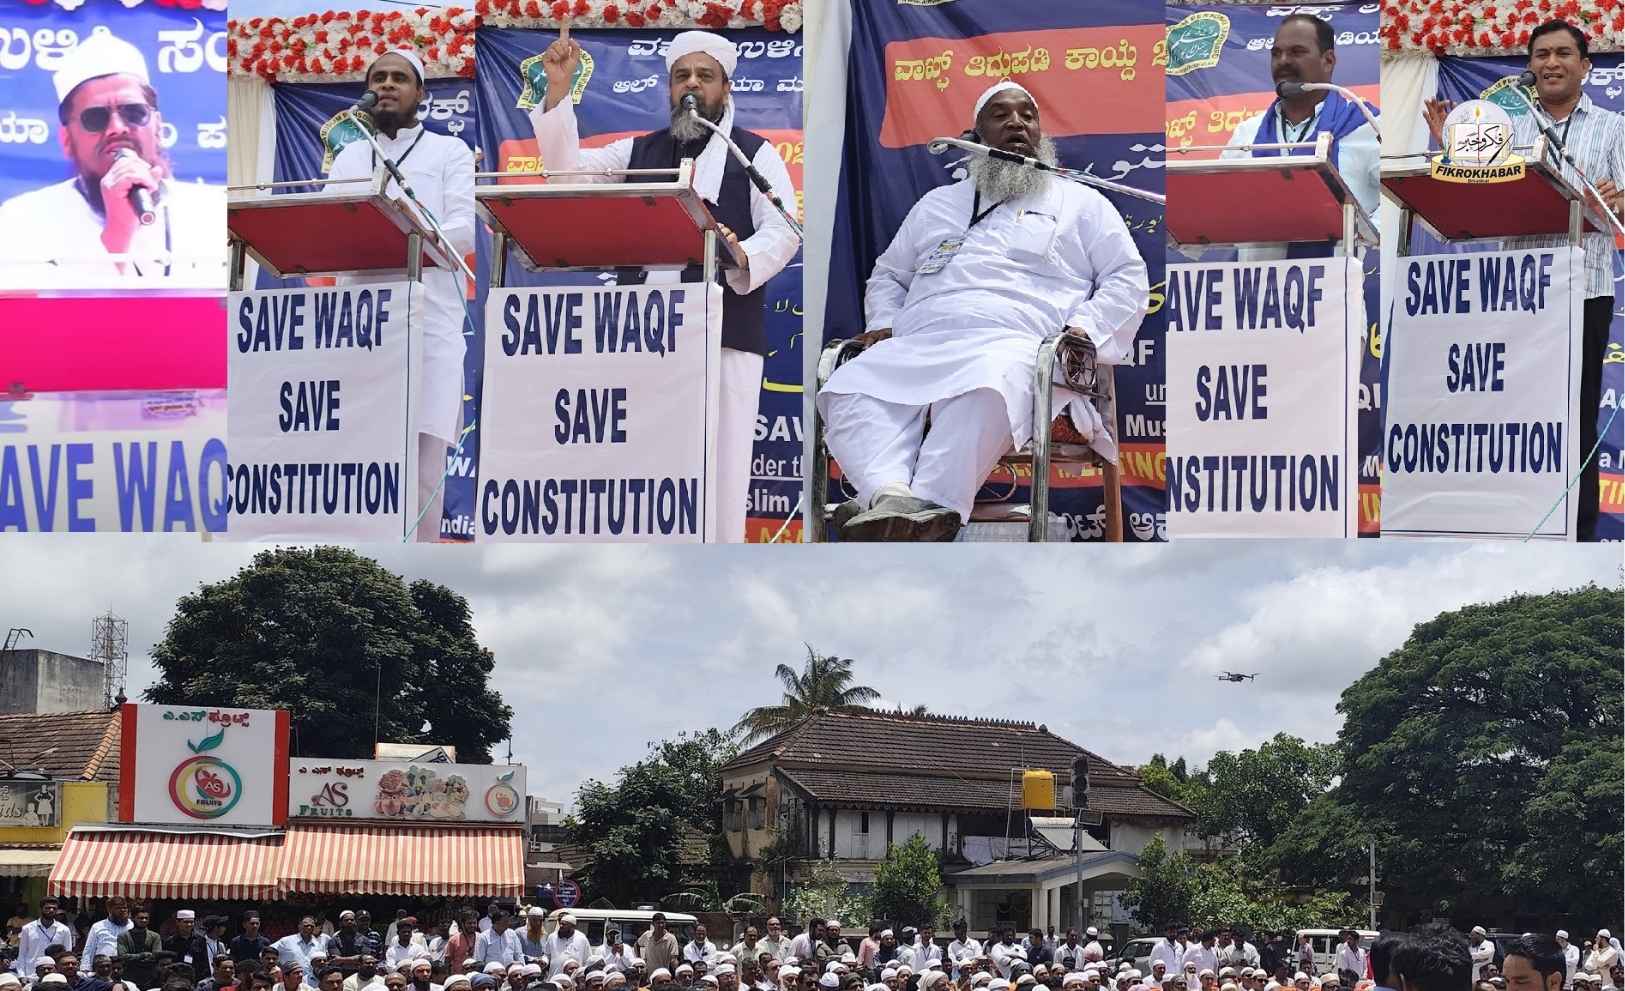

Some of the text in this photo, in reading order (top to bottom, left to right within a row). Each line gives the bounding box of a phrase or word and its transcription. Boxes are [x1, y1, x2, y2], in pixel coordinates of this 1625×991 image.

[1233, 265, 1325, 333] WAQF
[1405, 254, 1554, 317] SAVE WAQF
[237, 289, 392, 353] SAVE WAQF
[502, 290, 685, 358] SAVE WAQF
[1195, 364, 1267, 421] SAVE
[1447, 342, 1505, 393] SAVE
[279, 380, 340, 433] SAVE
[555, 388, 627, 445] SAVE
[1388, 422, 1562, 474] CONSTITUTION
[482, 478, 698, 536] CONSTITUTION
[311, 782, 349, 807] AS
